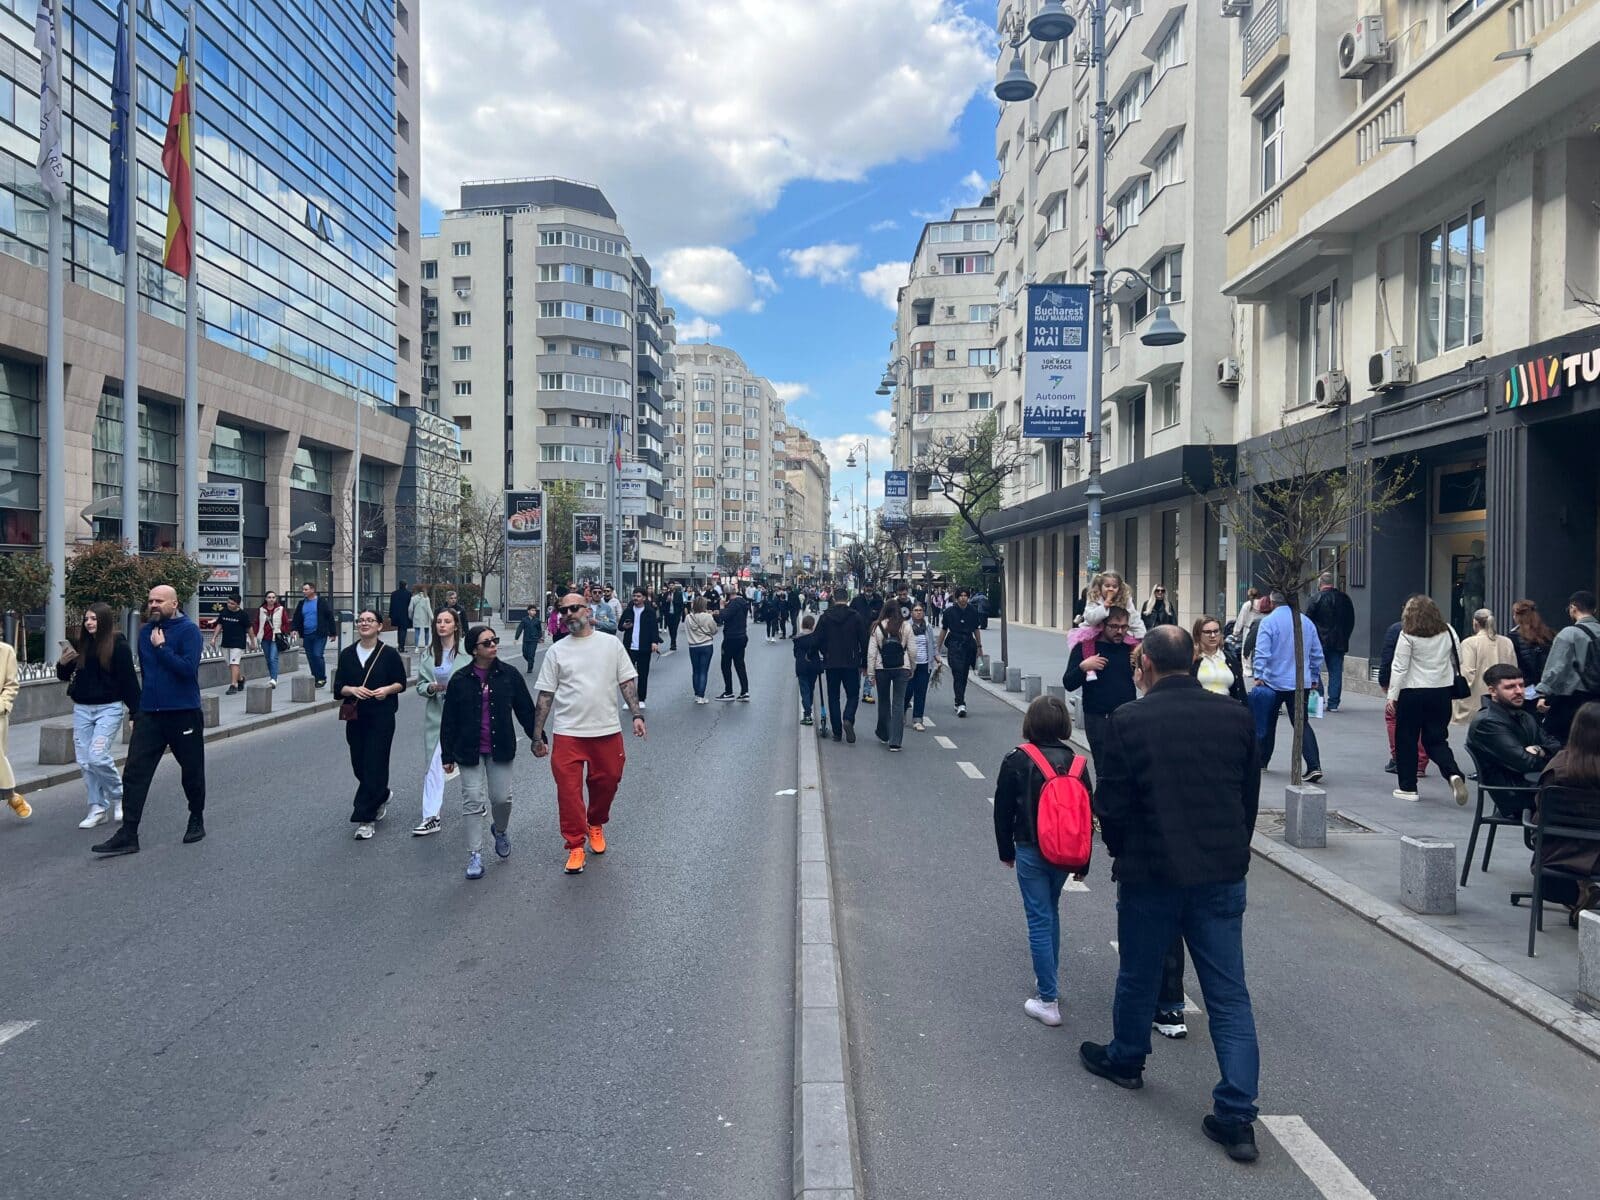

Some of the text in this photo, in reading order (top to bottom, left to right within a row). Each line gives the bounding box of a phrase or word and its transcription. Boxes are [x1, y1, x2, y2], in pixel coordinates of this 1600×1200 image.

[1035, 305, 1083, 315] Bucharest
[1034, 326, 1059, 335] 10-11
[1034, 335, 1059, 346] MAI
[1024, 405, 1086, 417] #AimFar
